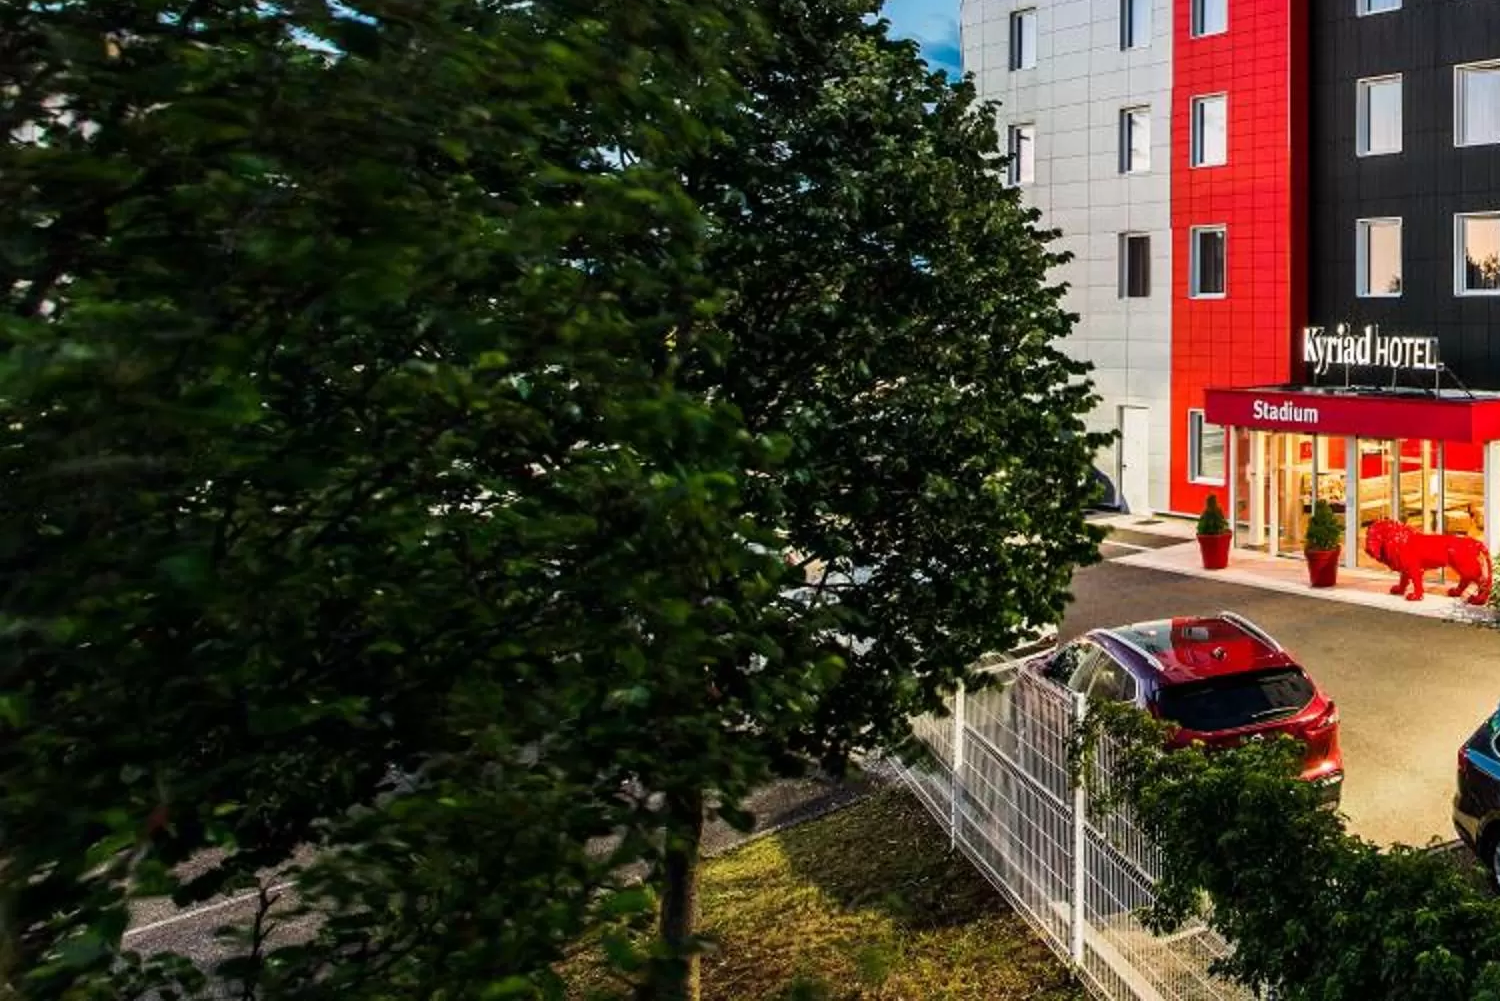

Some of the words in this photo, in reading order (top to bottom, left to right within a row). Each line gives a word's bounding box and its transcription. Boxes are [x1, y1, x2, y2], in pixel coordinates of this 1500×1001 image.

[1303, 323, 1373, 375] Kyriad
[1375, 336, 1439, 370] HOTEL
[1253, 399, 1319, 424] Stadium
